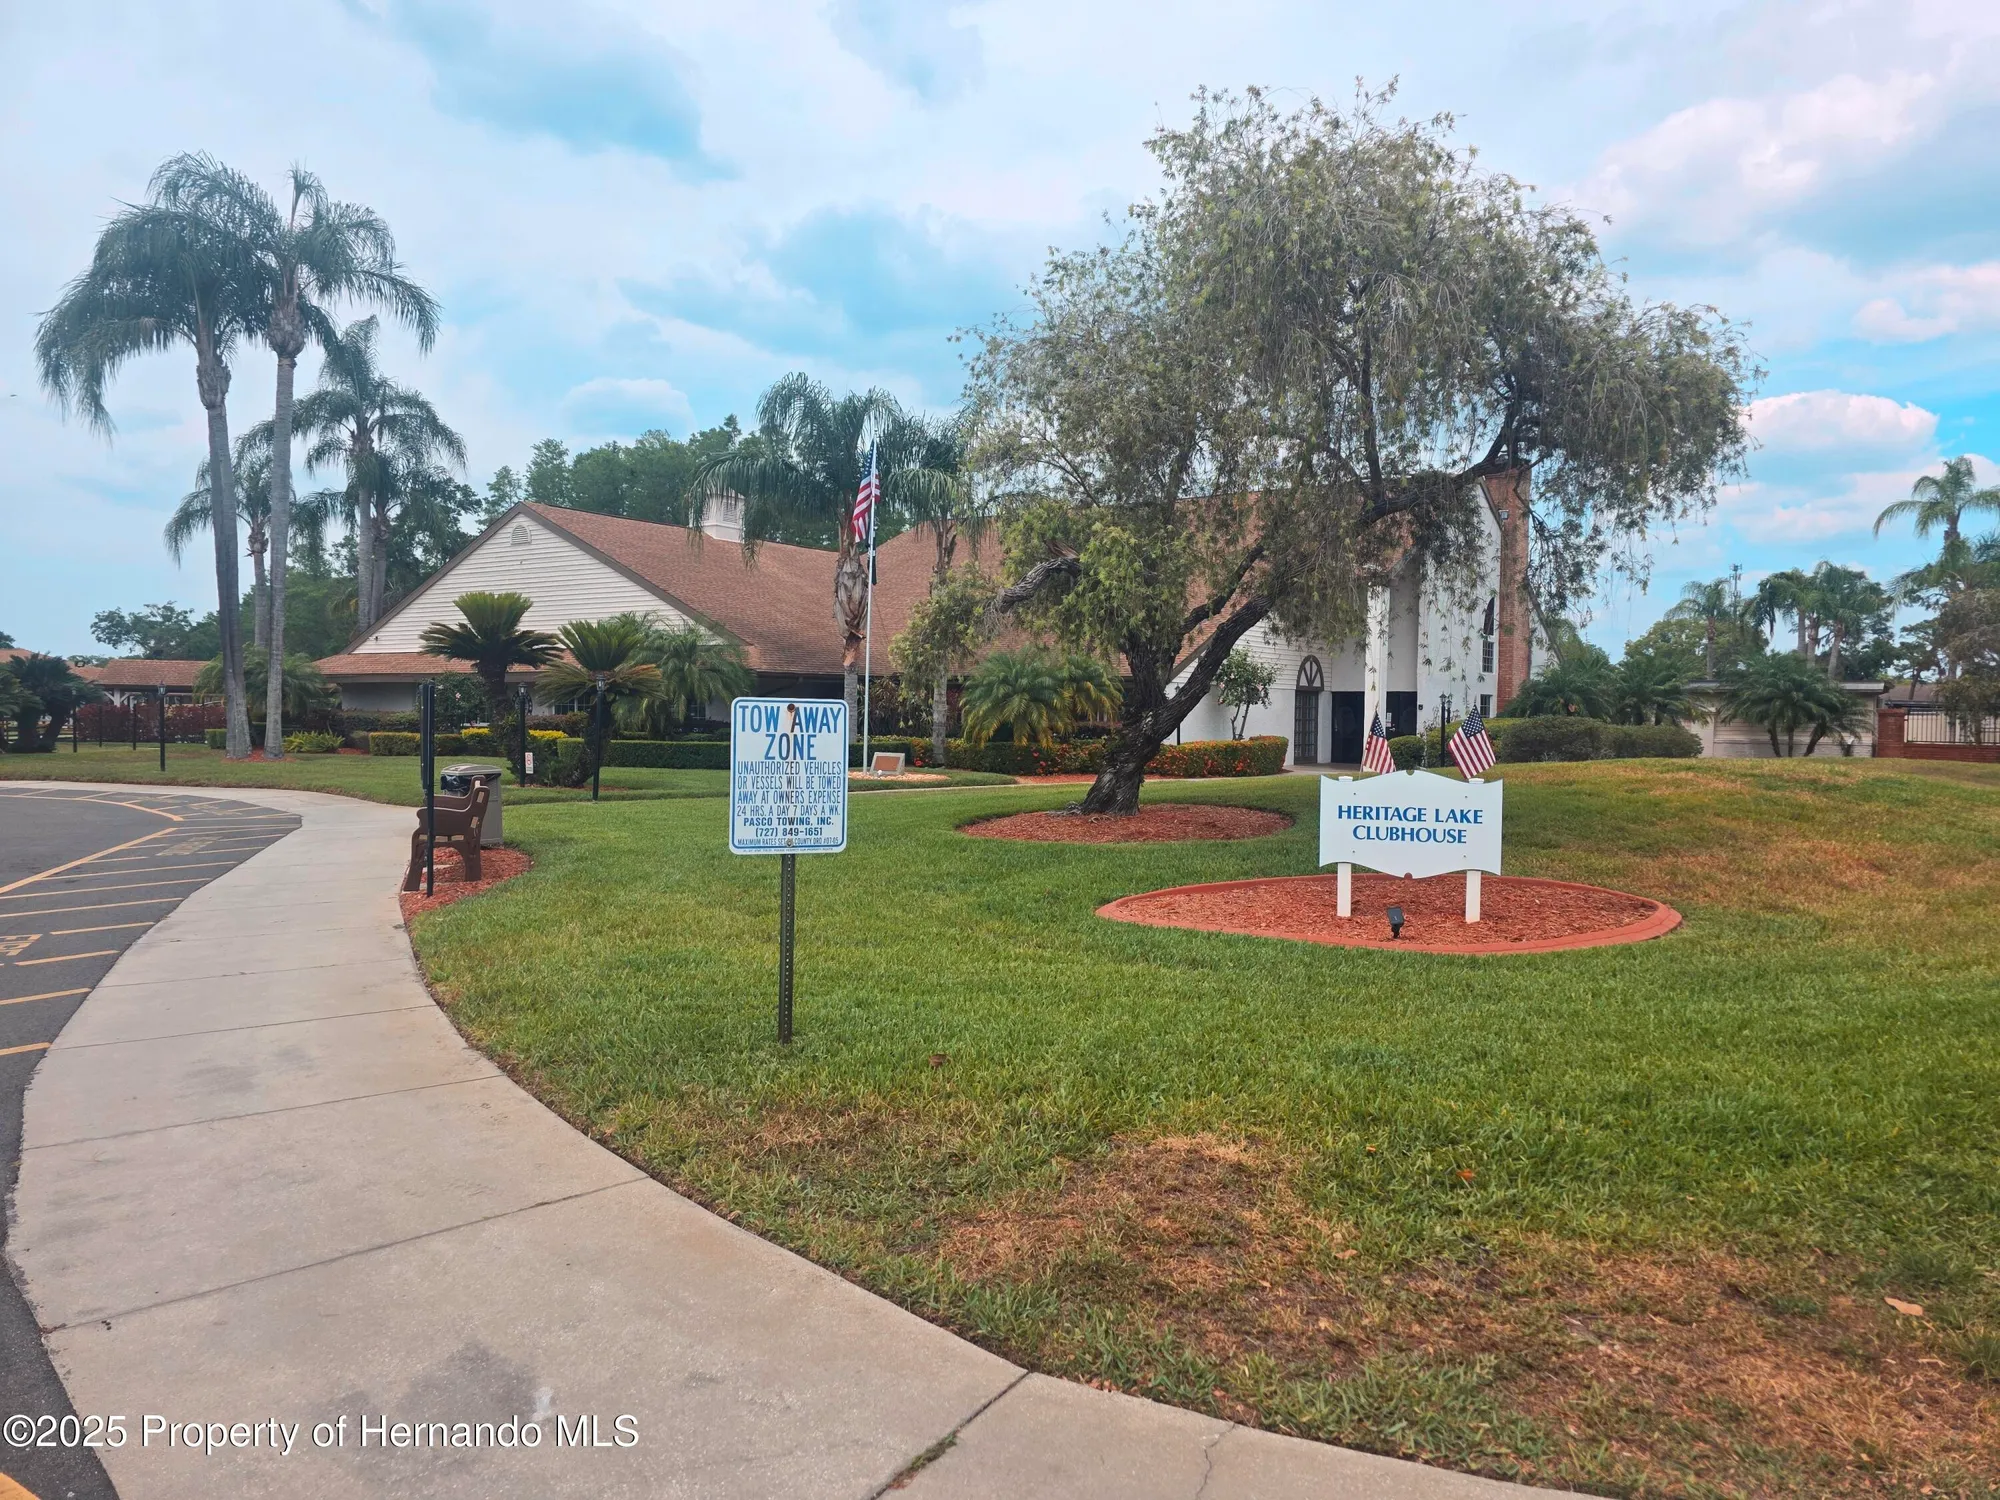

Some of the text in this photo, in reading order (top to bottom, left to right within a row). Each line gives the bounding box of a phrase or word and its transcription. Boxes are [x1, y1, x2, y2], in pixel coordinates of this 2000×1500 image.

[738, 704, 842, 733] TOW AWAY
[764, 732, 817, 760] ZONE
[737, 760, 842, 775] UNAUTHORIZED VEHICLES
[737, 775, 841, 790] OR VESSELS WILL BE TOWED
[737, 790, 841, 805] AWAY AT OWNERS EXPENSE
[736, 804, 841, 817] 24 HRS. A DAY 7 DAYS A WK.
[1337, 805, 1483, 824] HERITAGE LAKE
[743, 816, 834, 827] PASCO TOWING, INC.
[755, 827, 823, 838] (727) 849-1651
[1352, 825, 1467, 844] CLUBHOUSE
[737, 838, 761, 846] MAXIMUM
[762, 838, 777, 846] RATES
[777, 837, 786, 846] SET
[794, 837, 812, 845] COUNTY
